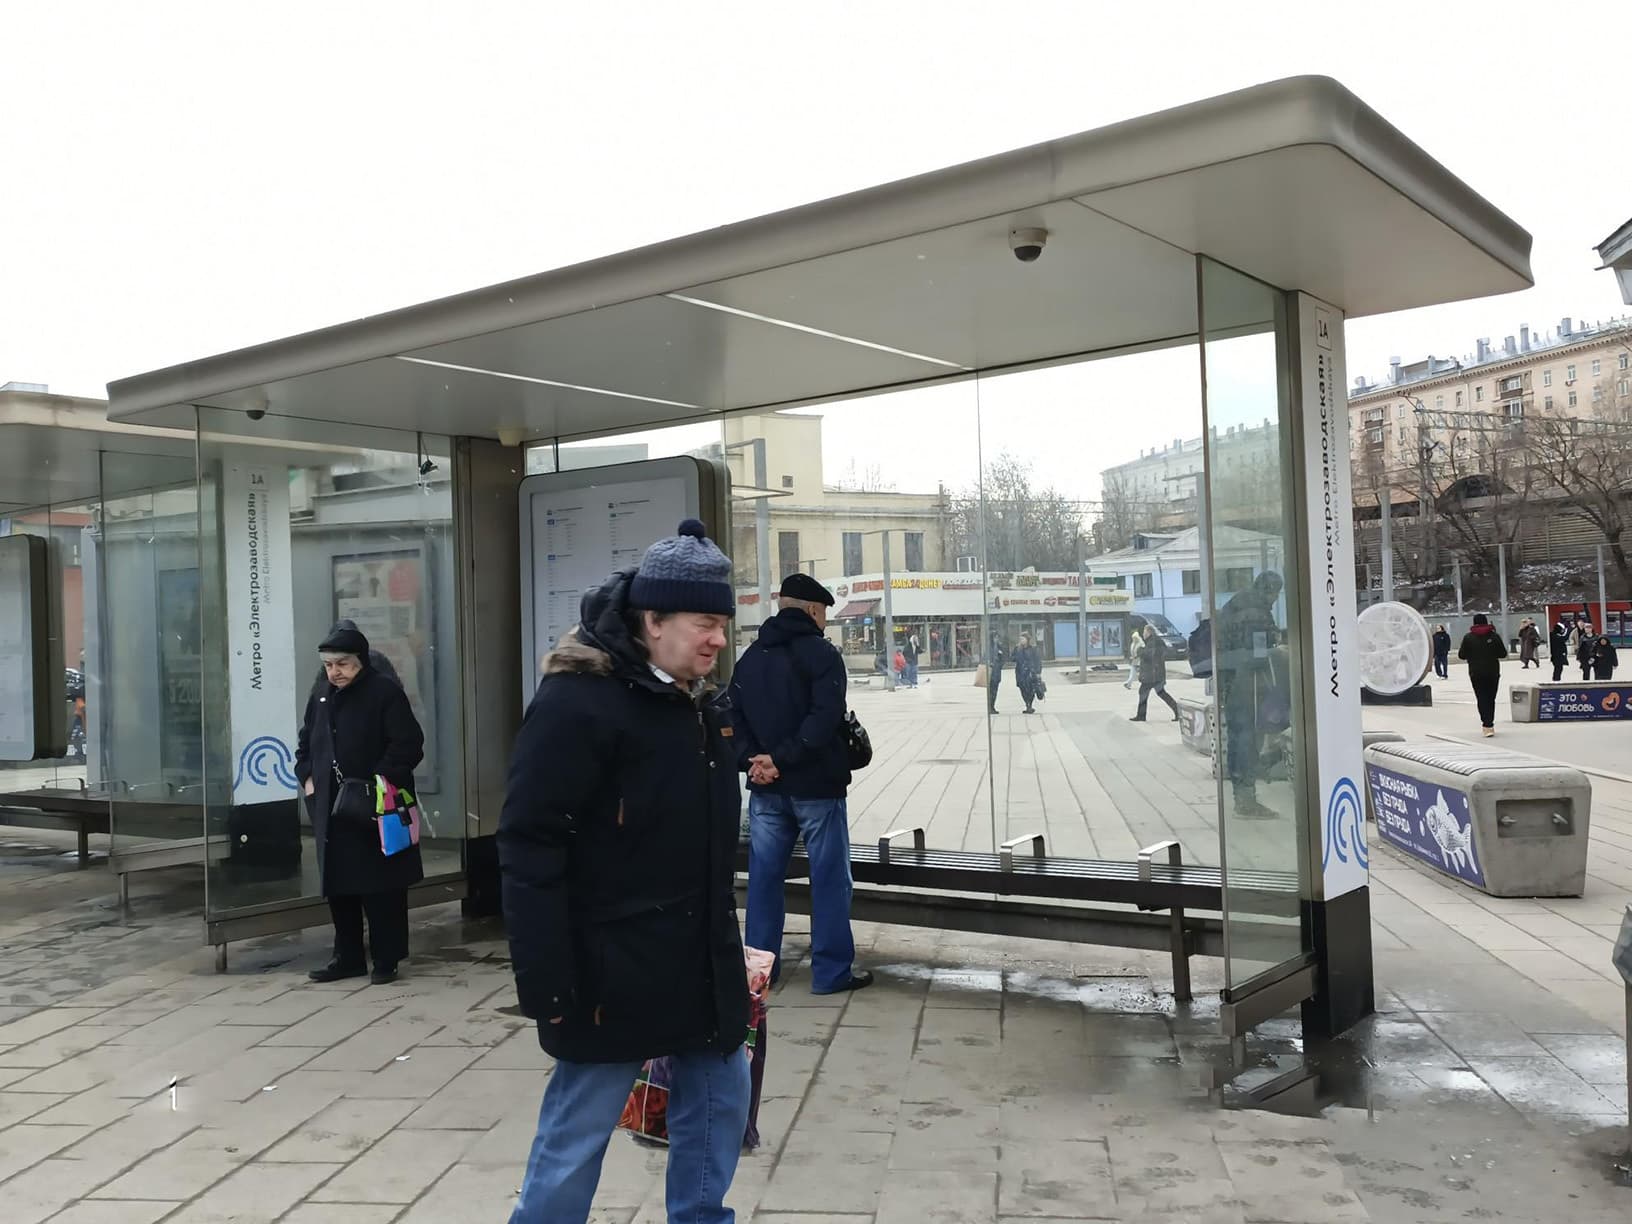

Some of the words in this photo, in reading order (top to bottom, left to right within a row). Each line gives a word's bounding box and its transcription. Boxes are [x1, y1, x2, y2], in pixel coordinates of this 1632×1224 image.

[1318, 354, 1336, 607] «Электрозаводская»
[247, 492, 261, 638] «Электрозаводская»
[1068, 575, 1092, 587] ТААК
[249, 642, 263, 690] Метро
[1330, 615, 1340, 698] Метро
[1558, 702, 1595, 713] ЛЮБОВЬ
[1559, 693, 1577, 702] ЭТО
